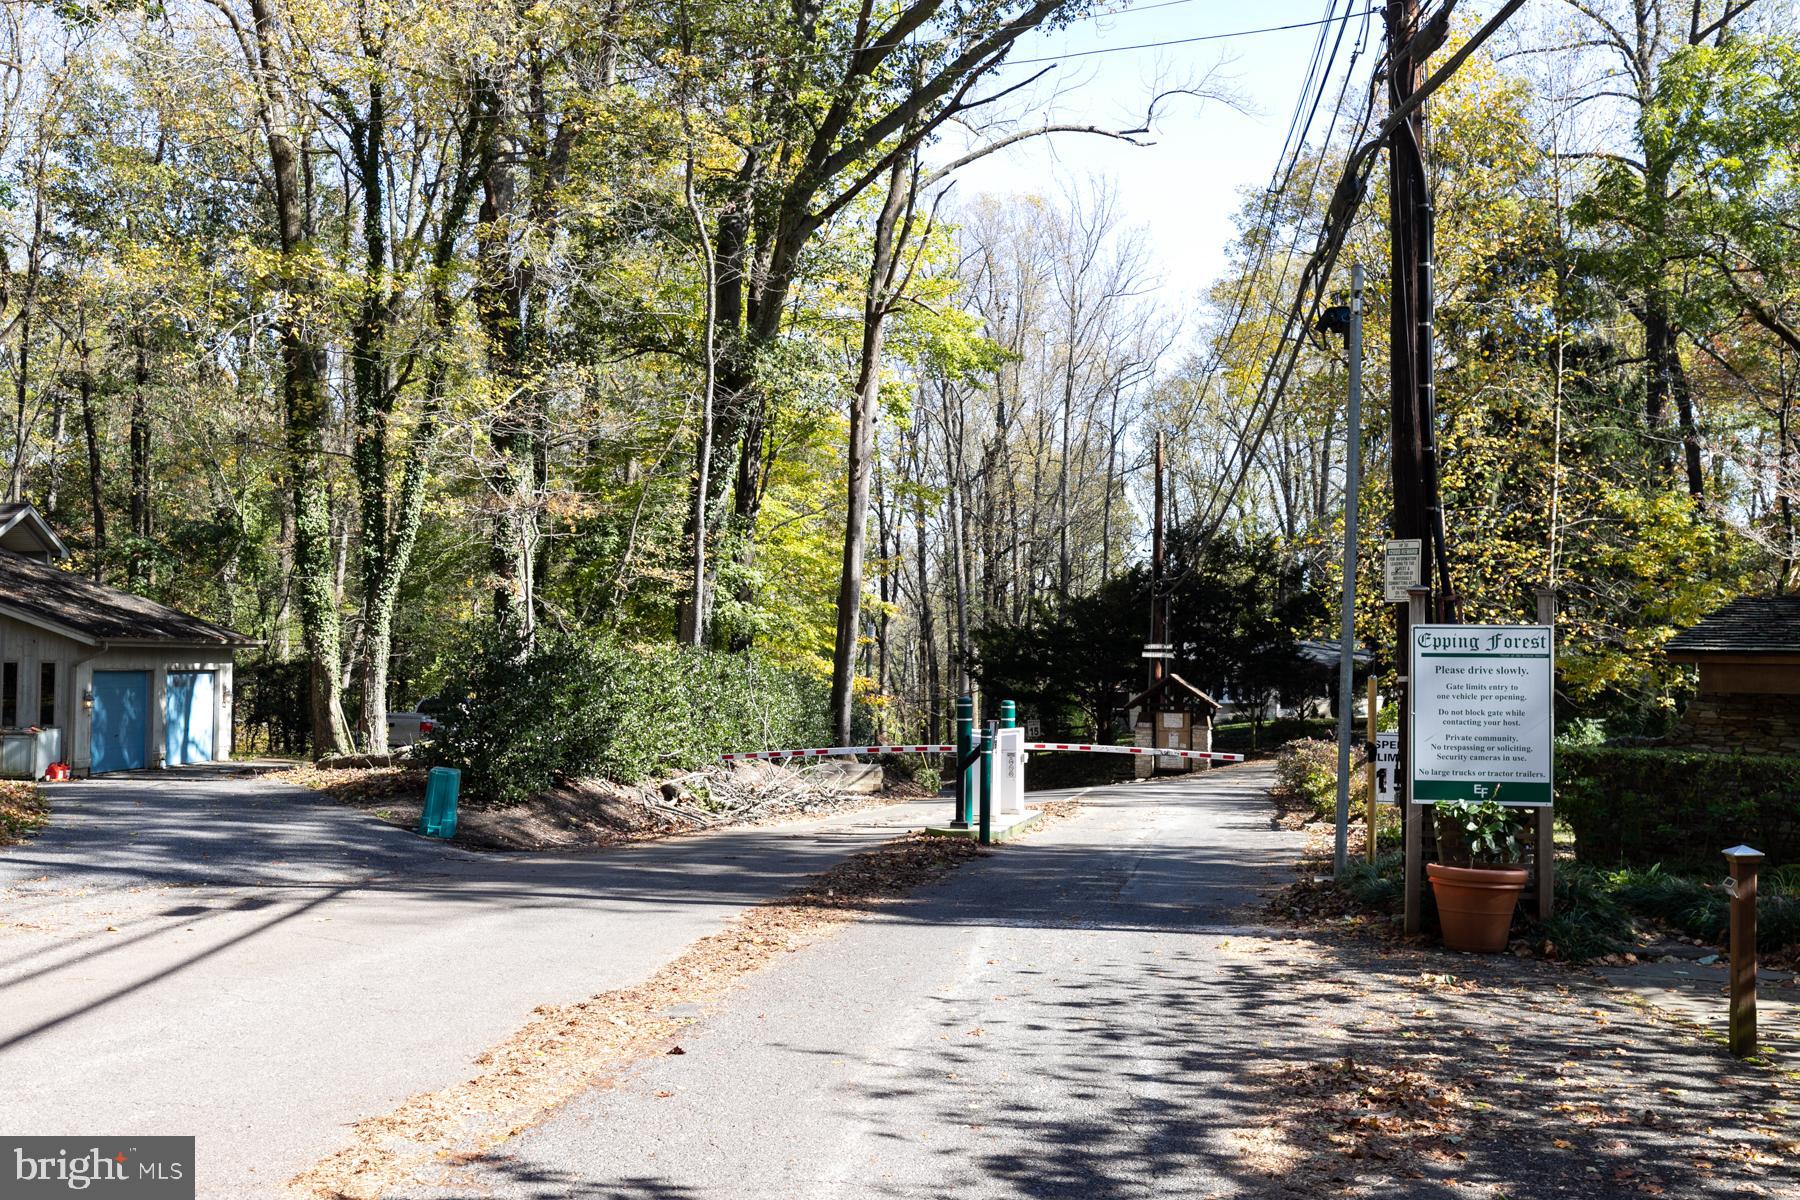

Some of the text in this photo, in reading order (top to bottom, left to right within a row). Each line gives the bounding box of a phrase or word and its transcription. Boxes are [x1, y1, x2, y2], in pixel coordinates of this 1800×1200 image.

[1418, 632, 1546, 651] Epping Forest
[1435, 666, 1529, 676] Please drive slowly.
[1030, 727, 1039, 735] 15
[1474, 735, 1518, 743] community.
[1376, 740, 1400, 749] SPE
[1377, 753, 1398, 762] LIM
[1432, 769, 1450, 777] large
[1474, 784, 1488, 798] EF
